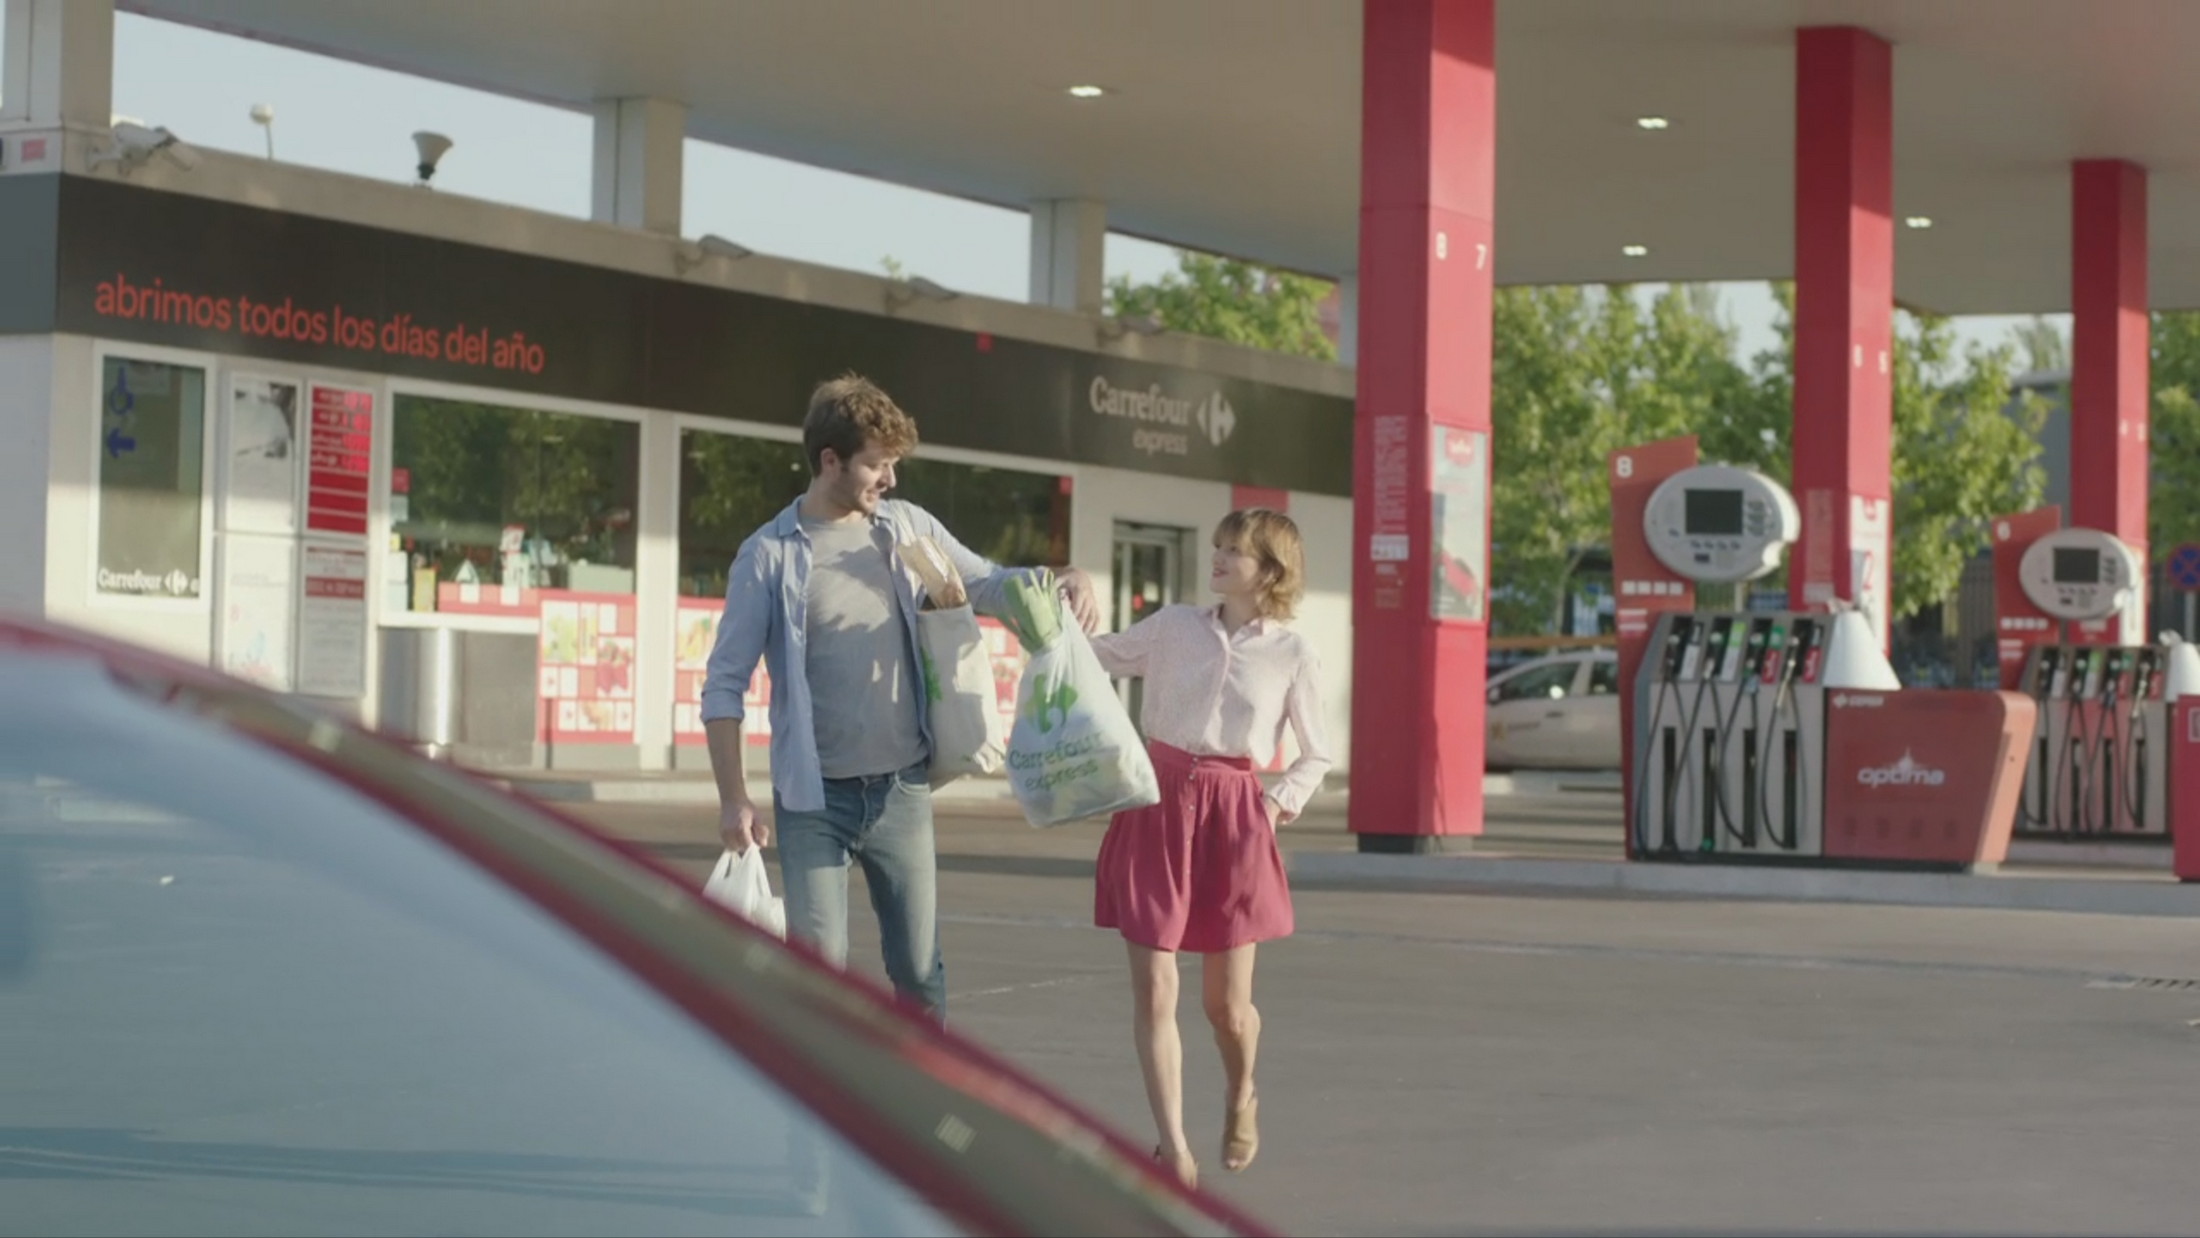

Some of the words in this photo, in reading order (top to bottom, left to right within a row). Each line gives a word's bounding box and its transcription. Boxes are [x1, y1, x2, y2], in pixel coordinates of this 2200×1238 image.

[1475, 243, 1487, 270] 7
[95, 271, 233, 333] abrimos
[238, 295, 328, 345] todos
[333, 304, 376, 351] los
[380, 313, 441, 360] días
[445, 322, 488, 367] del
[493, 330, 545, 375] año
[1089, 375, 1191, 427] Carrefour
[1132, 428, 1188, 457] express
[1616, 455, 1634, 479] 8
[98, 567, 163, 591] Carrefour
[1008, 731, 1103, 772] Carrefour
[1024, 757, 1099, 792] express
[1856, 757, 1946, 790] optima
